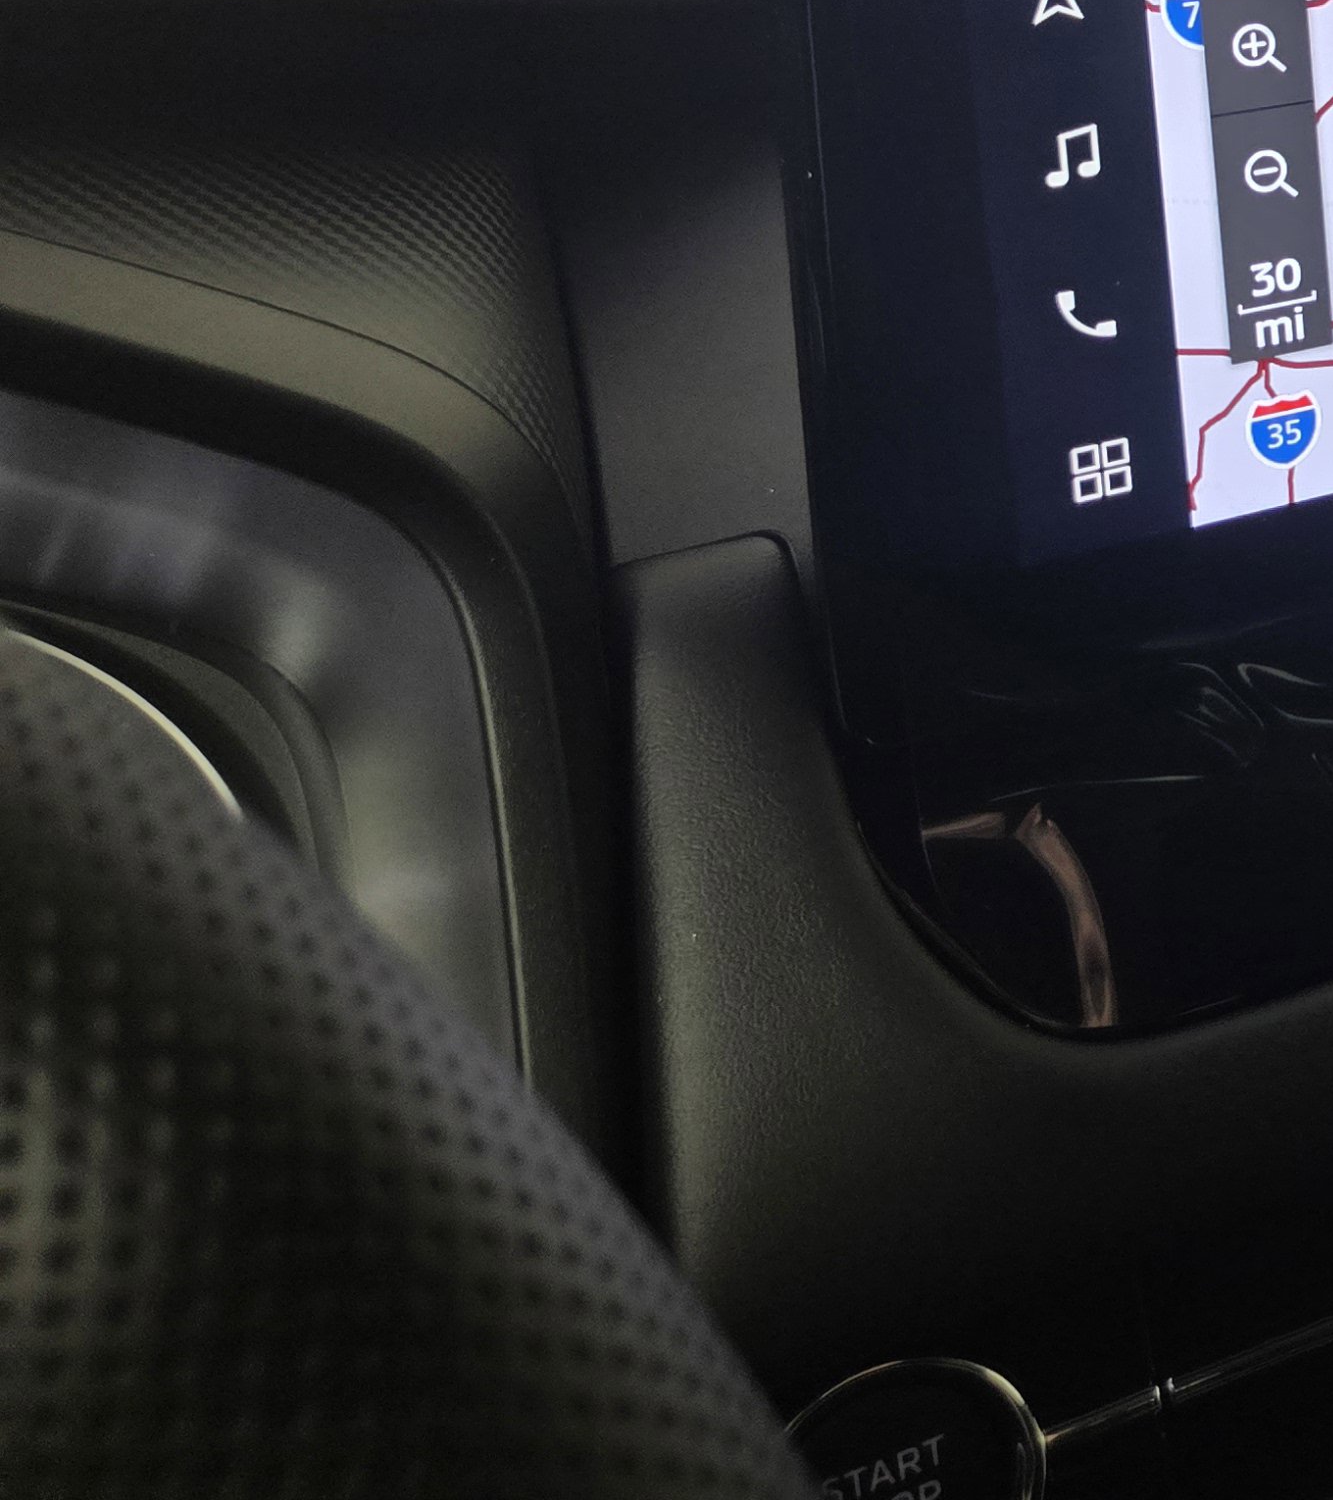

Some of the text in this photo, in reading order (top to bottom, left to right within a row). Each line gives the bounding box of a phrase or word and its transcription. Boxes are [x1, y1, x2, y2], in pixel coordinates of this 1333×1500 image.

[1251, 257, 1302, 298] 30
[1256, 308, 1305, 348] mi
[1267, 420, 1302, 448] 35
[822, 1433, 945, 1500] START
